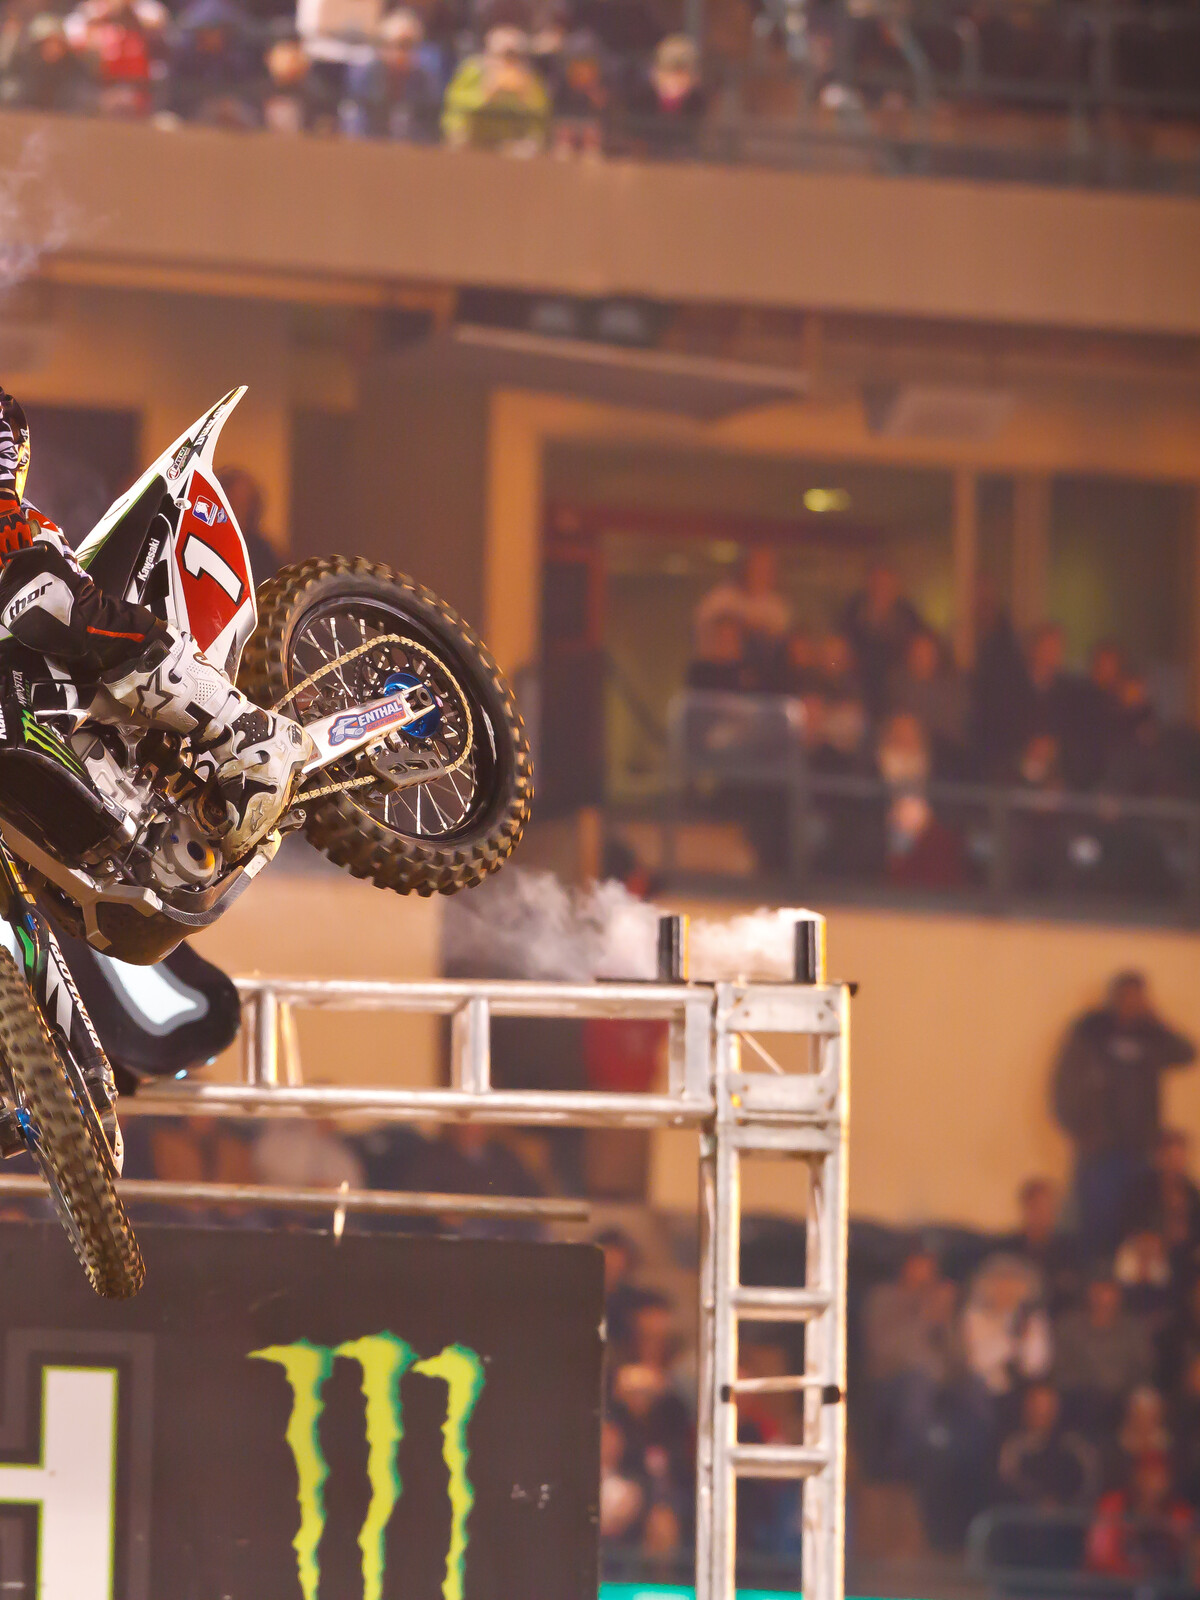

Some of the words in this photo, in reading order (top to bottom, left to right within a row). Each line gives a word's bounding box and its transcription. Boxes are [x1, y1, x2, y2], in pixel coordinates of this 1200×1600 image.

[137, 538, 161, 582] Kawasaki
[182, 532, 245, 606] 1
[8, 581, 53, 621] thor
